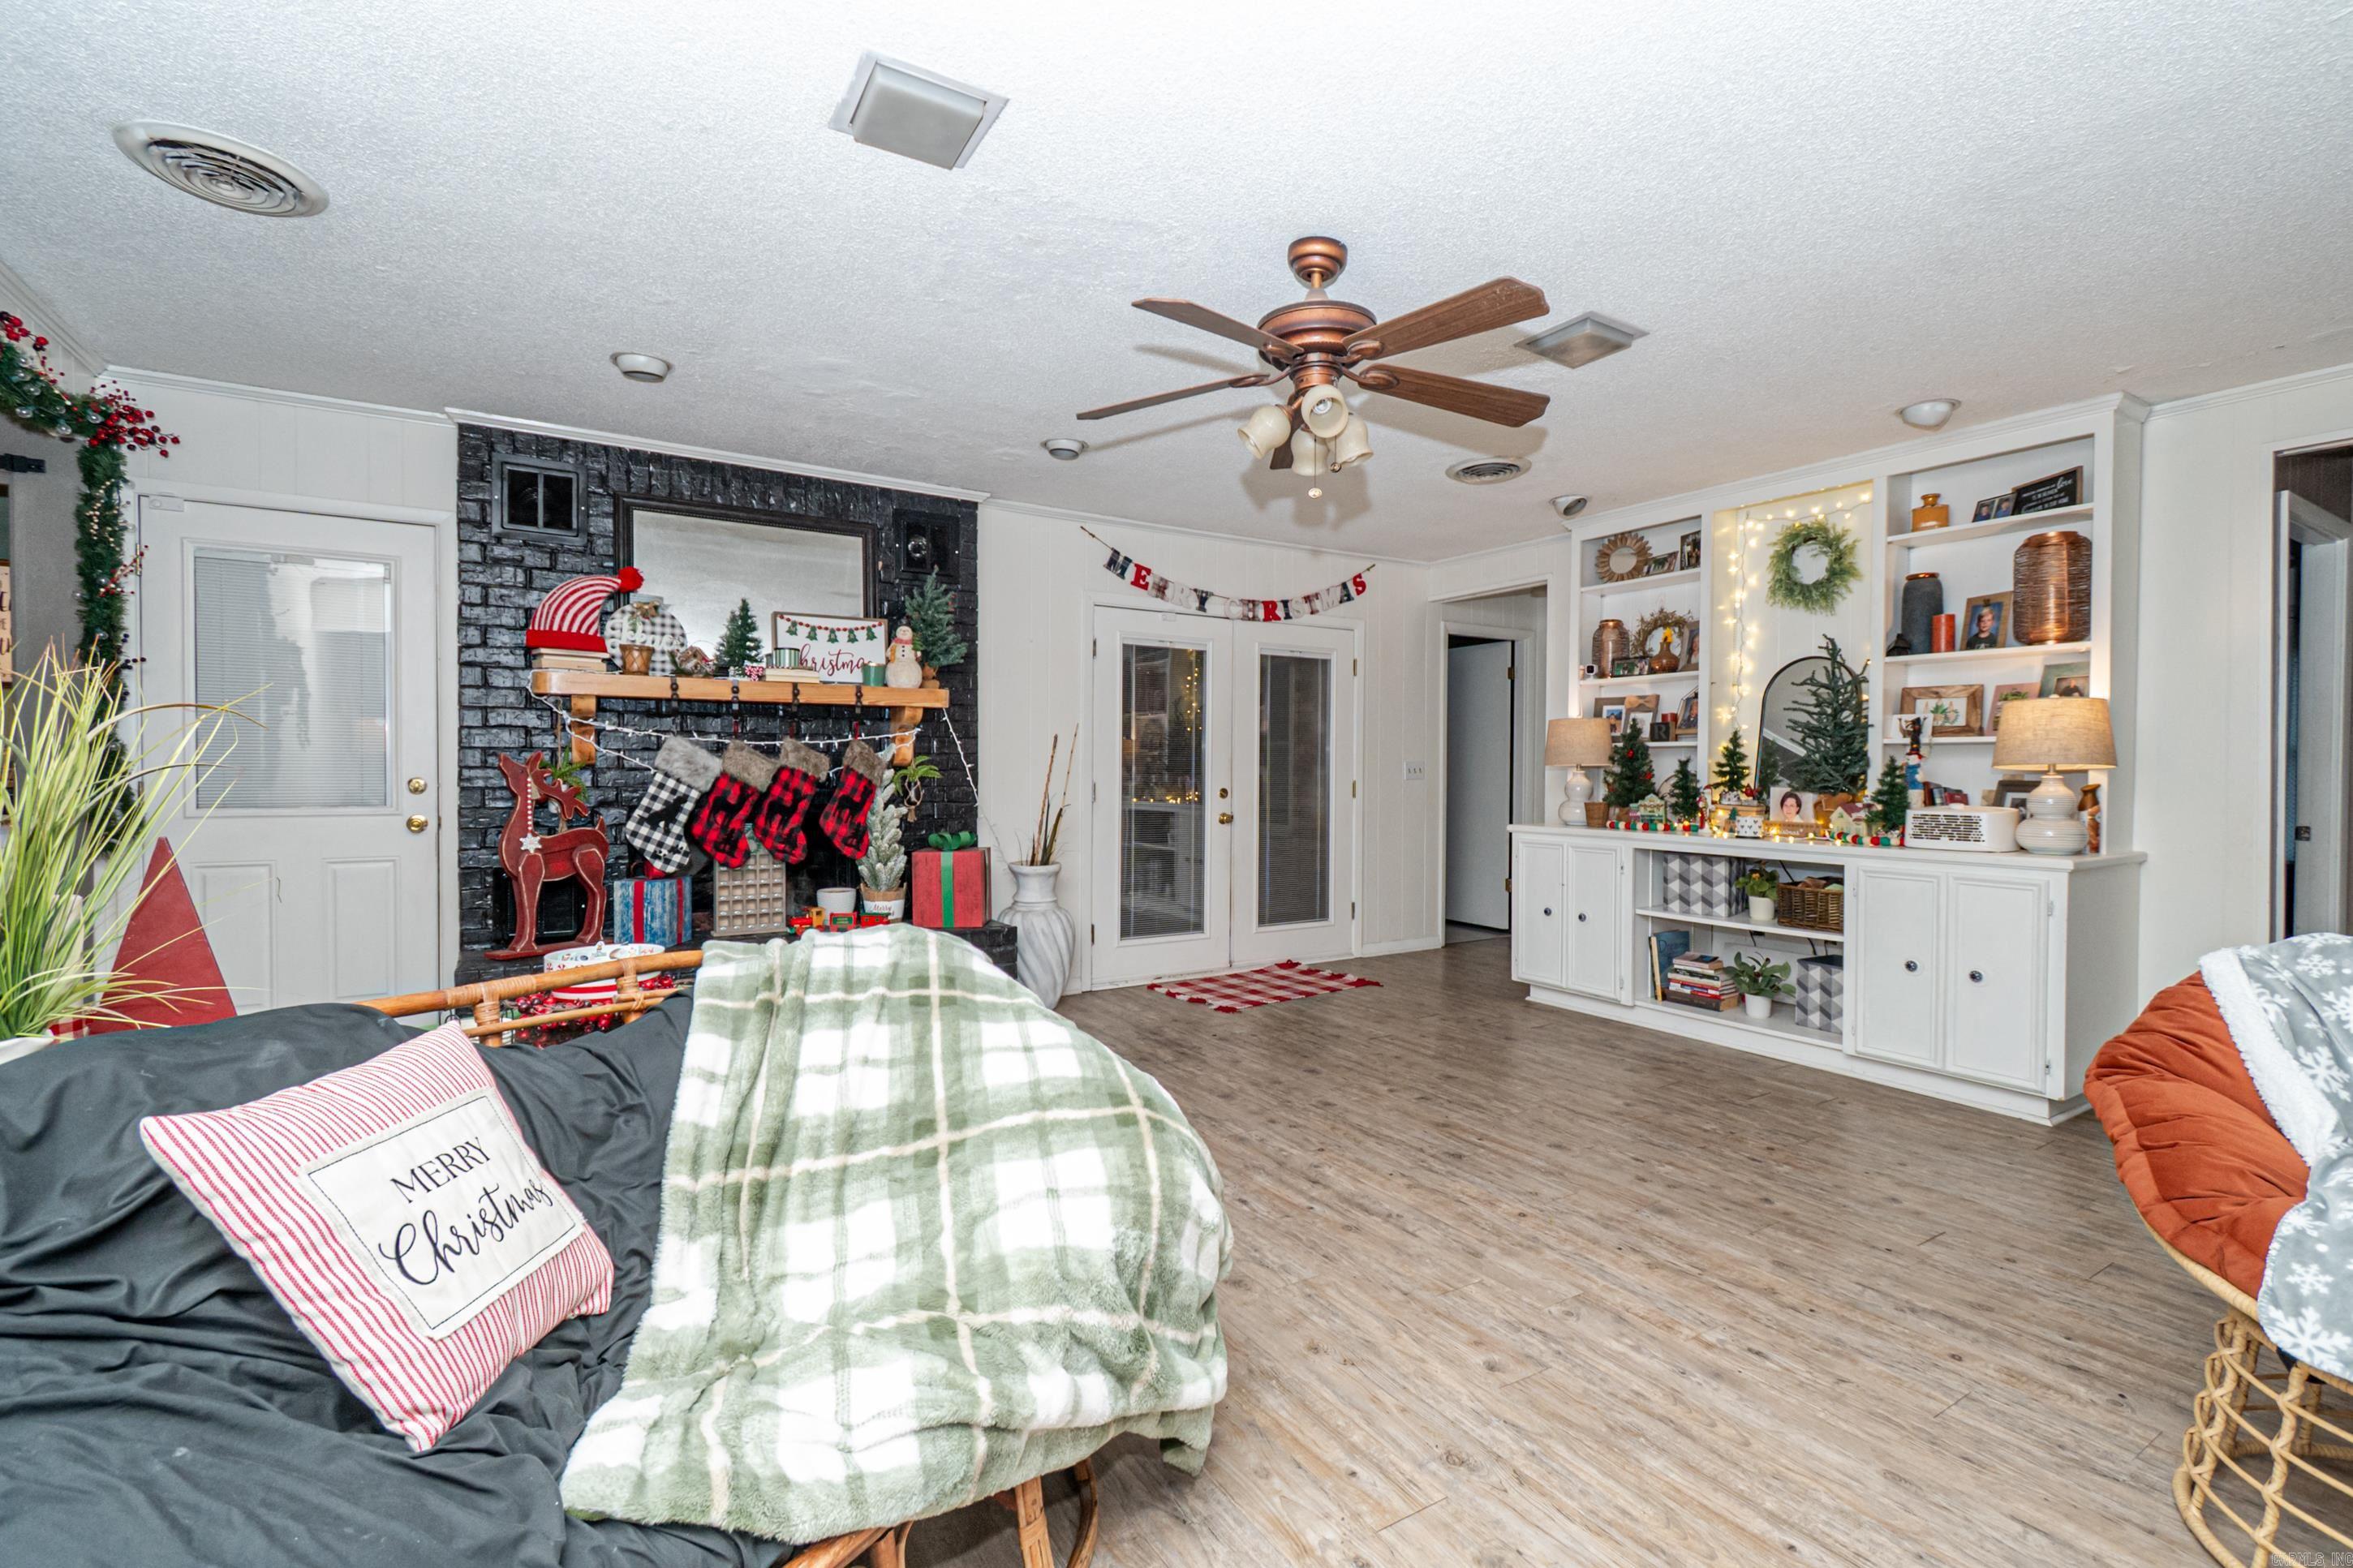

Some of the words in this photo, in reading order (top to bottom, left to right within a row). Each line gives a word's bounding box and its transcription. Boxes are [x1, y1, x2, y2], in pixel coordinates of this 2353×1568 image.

[1103, 548, 1214, 613] MERRY
[1224, 573, 1367, 622] CHRISTMAS
[389, 1136, 490, 1204] MERRY
[378, 1179, 553, 1285] Christmas
